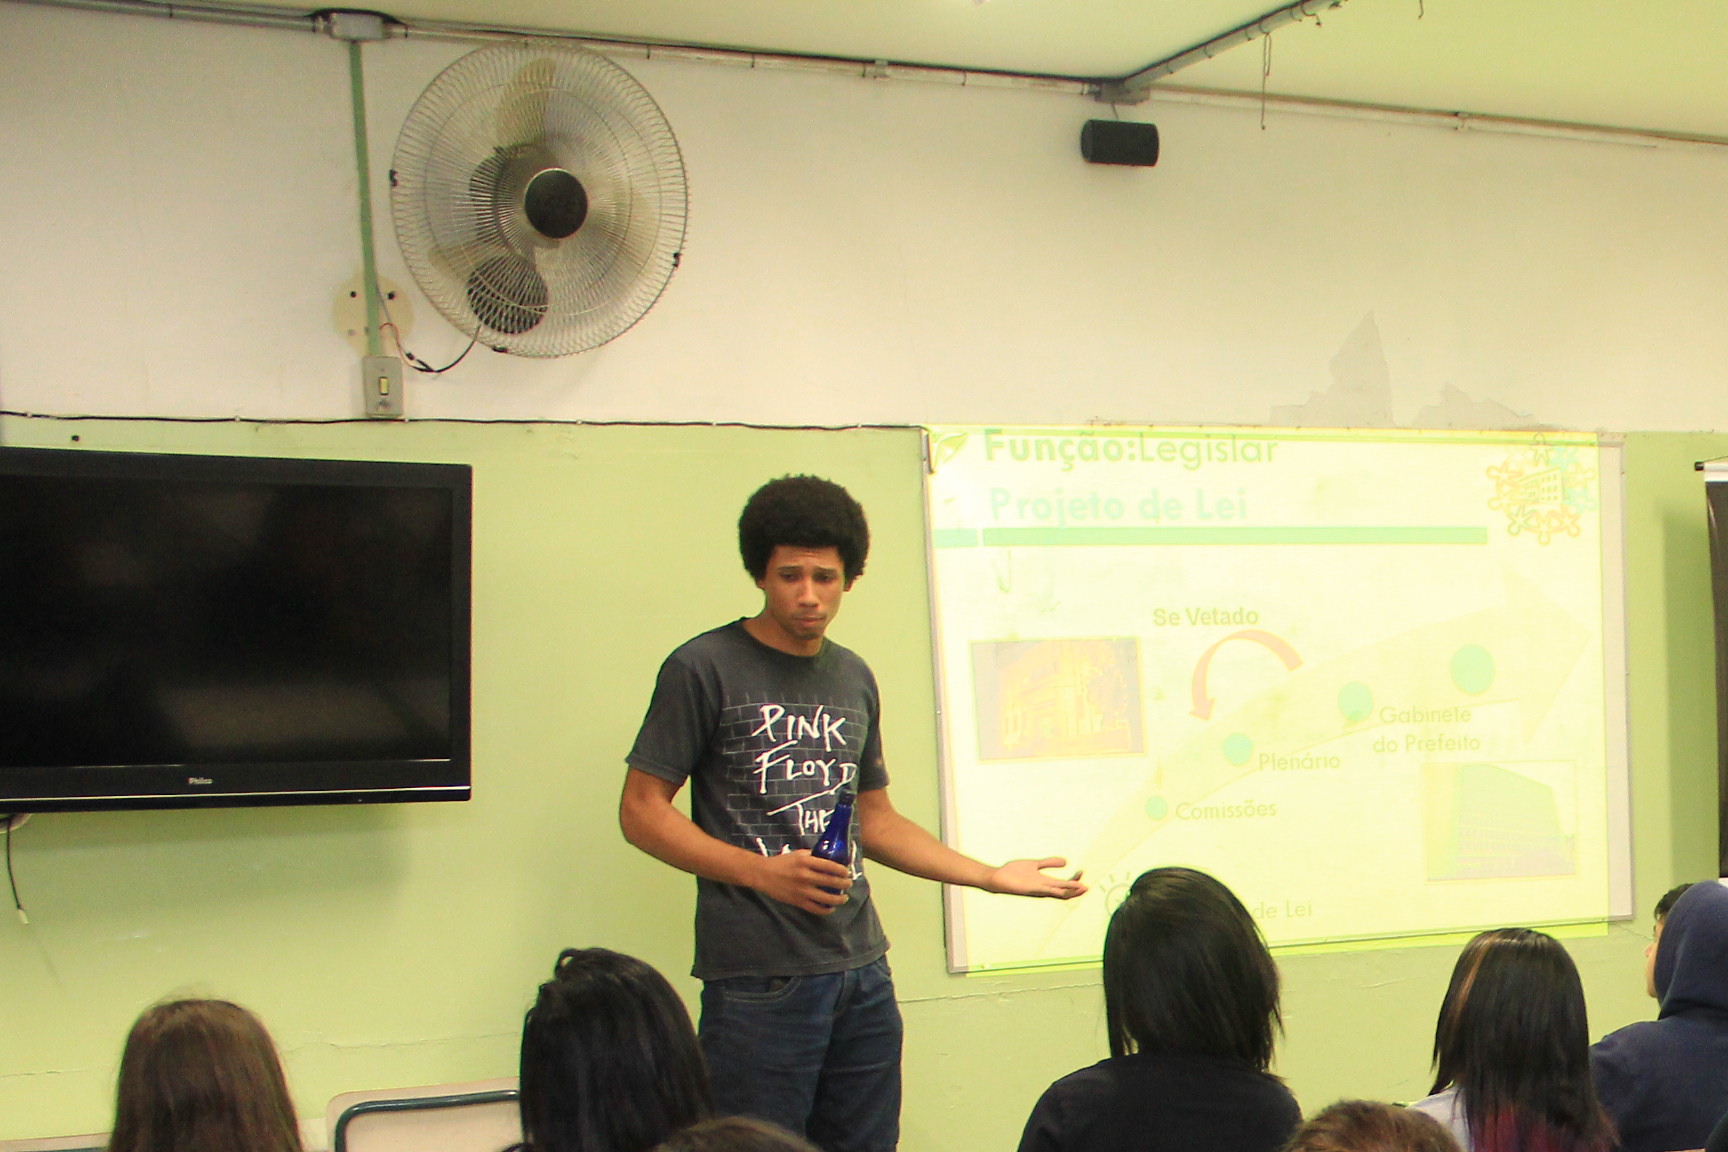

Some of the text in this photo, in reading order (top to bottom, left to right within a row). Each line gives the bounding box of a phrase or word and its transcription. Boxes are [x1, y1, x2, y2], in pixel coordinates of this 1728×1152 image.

[989, 487, 1247, 528] Projeto de Lei
[1153, 607, 1259, 626] Se Vetado
[1379, 705, 1473, 725] Gabinete
[751, 704, 847, 752] PINK
[1373, 733, 1481, 754] do Prefeito
[752, 739, 857, 795] FLOYD
[1258, 752, 1341, 772] Plenário
[1175, 799, 1277, 821] Comissões
[1253, 899, 1313, 919] de Lei
